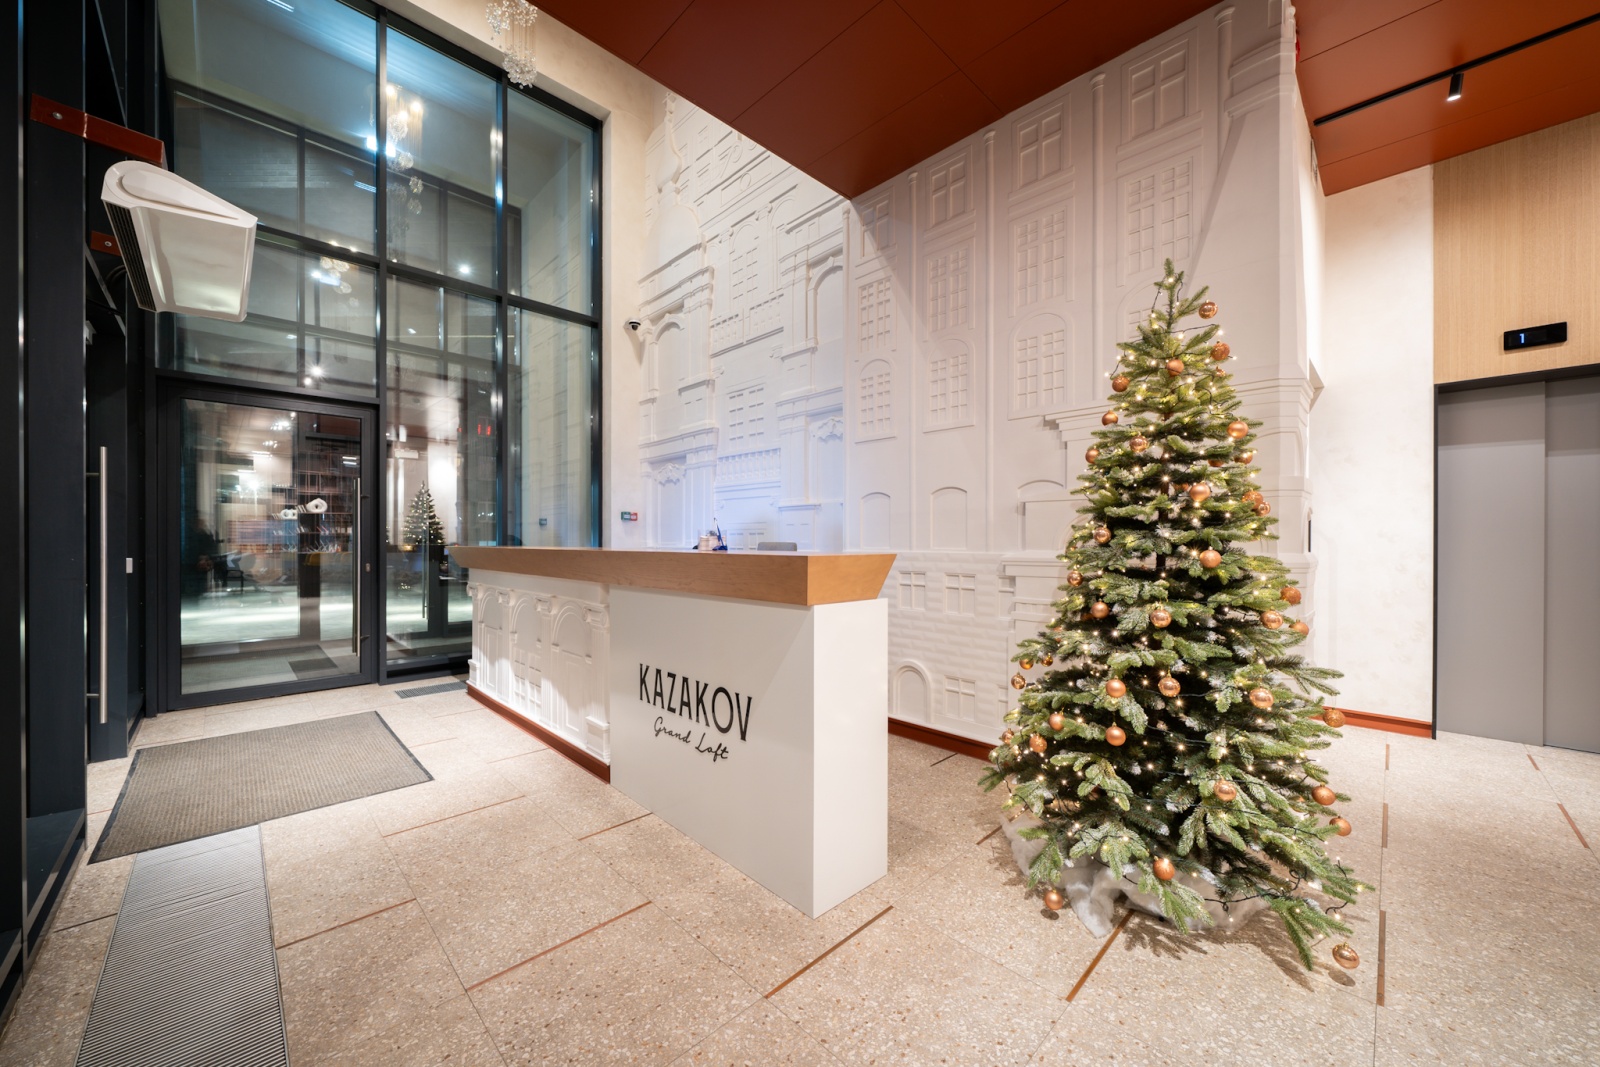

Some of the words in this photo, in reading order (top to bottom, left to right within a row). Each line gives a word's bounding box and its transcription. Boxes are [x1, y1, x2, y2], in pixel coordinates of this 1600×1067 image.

[1519, 333, 1525, 344] 1
[639, 663, 752, 742] KAZAKOV
[654, 716, 691, 744] Grand
[695, 732, 729, 762] Loft
